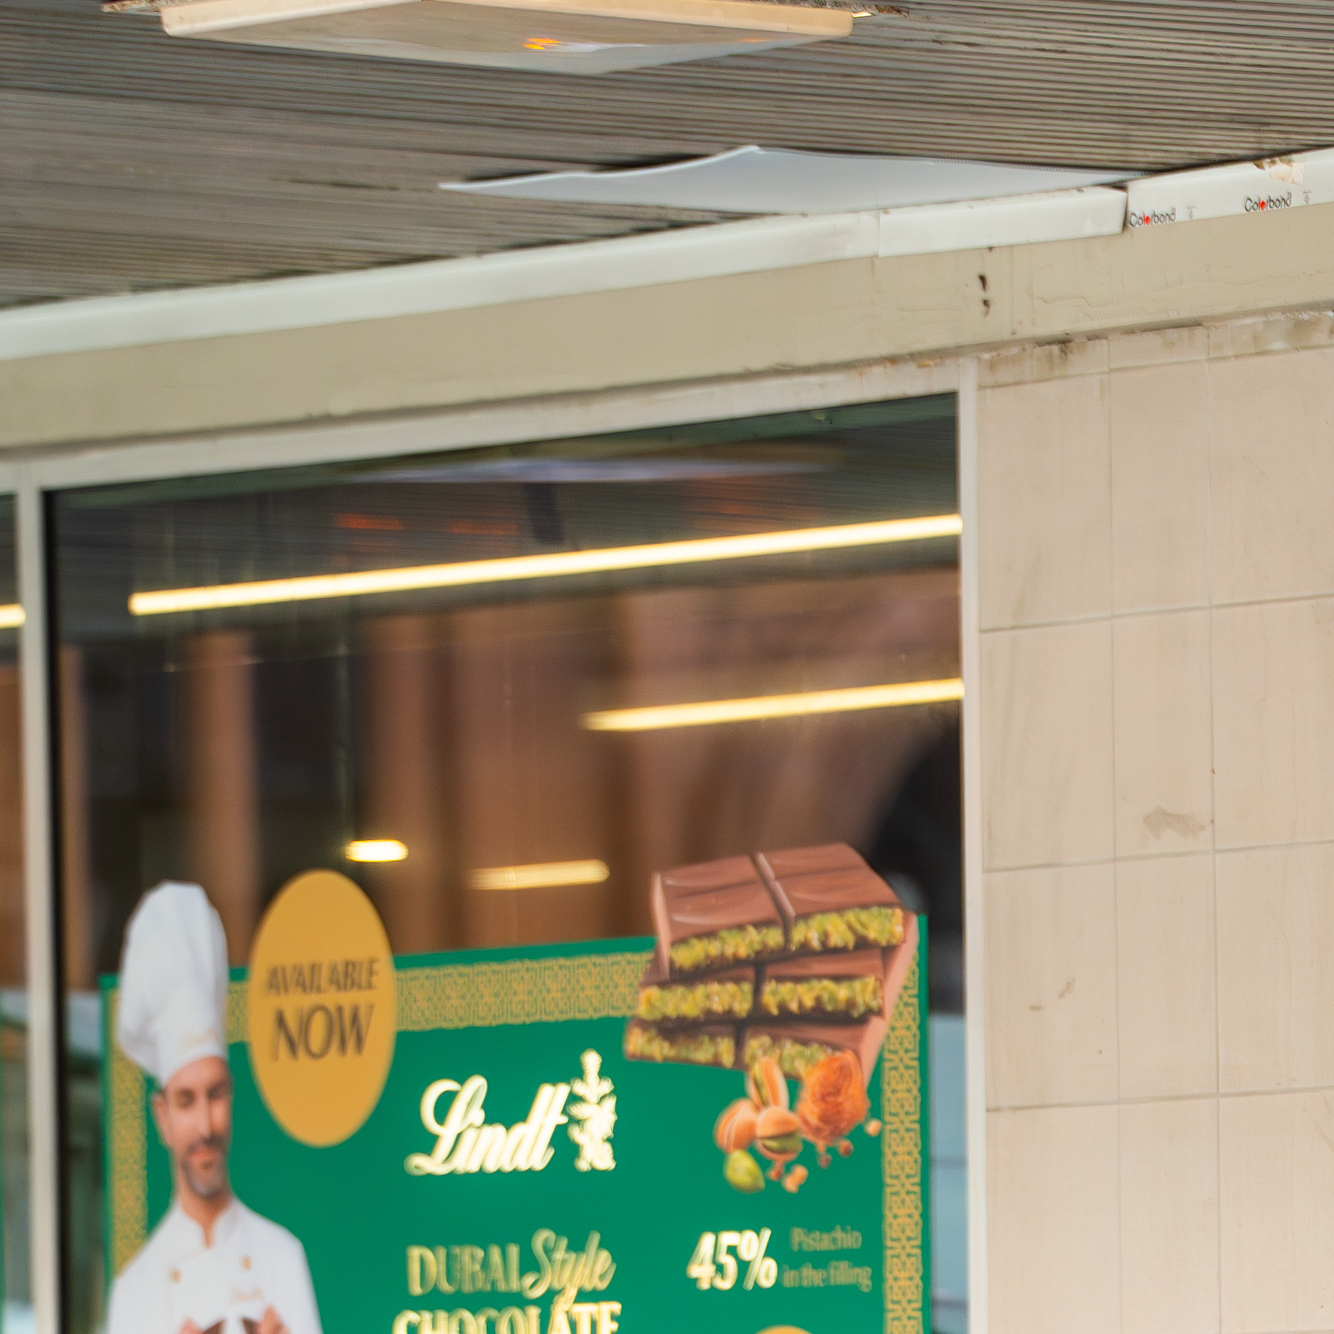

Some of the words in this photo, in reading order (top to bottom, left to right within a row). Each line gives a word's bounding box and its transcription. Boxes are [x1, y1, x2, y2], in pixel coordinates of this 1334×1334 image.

[1129, 207, 1177, 225] Colorbond
[1244, 190, 1293, 210] Colorbond
[273, 1003, 374, 1062] NOW
[404, 1074, 572, 1176] Lindt
[686, 1226, 779, 1291] 45%
